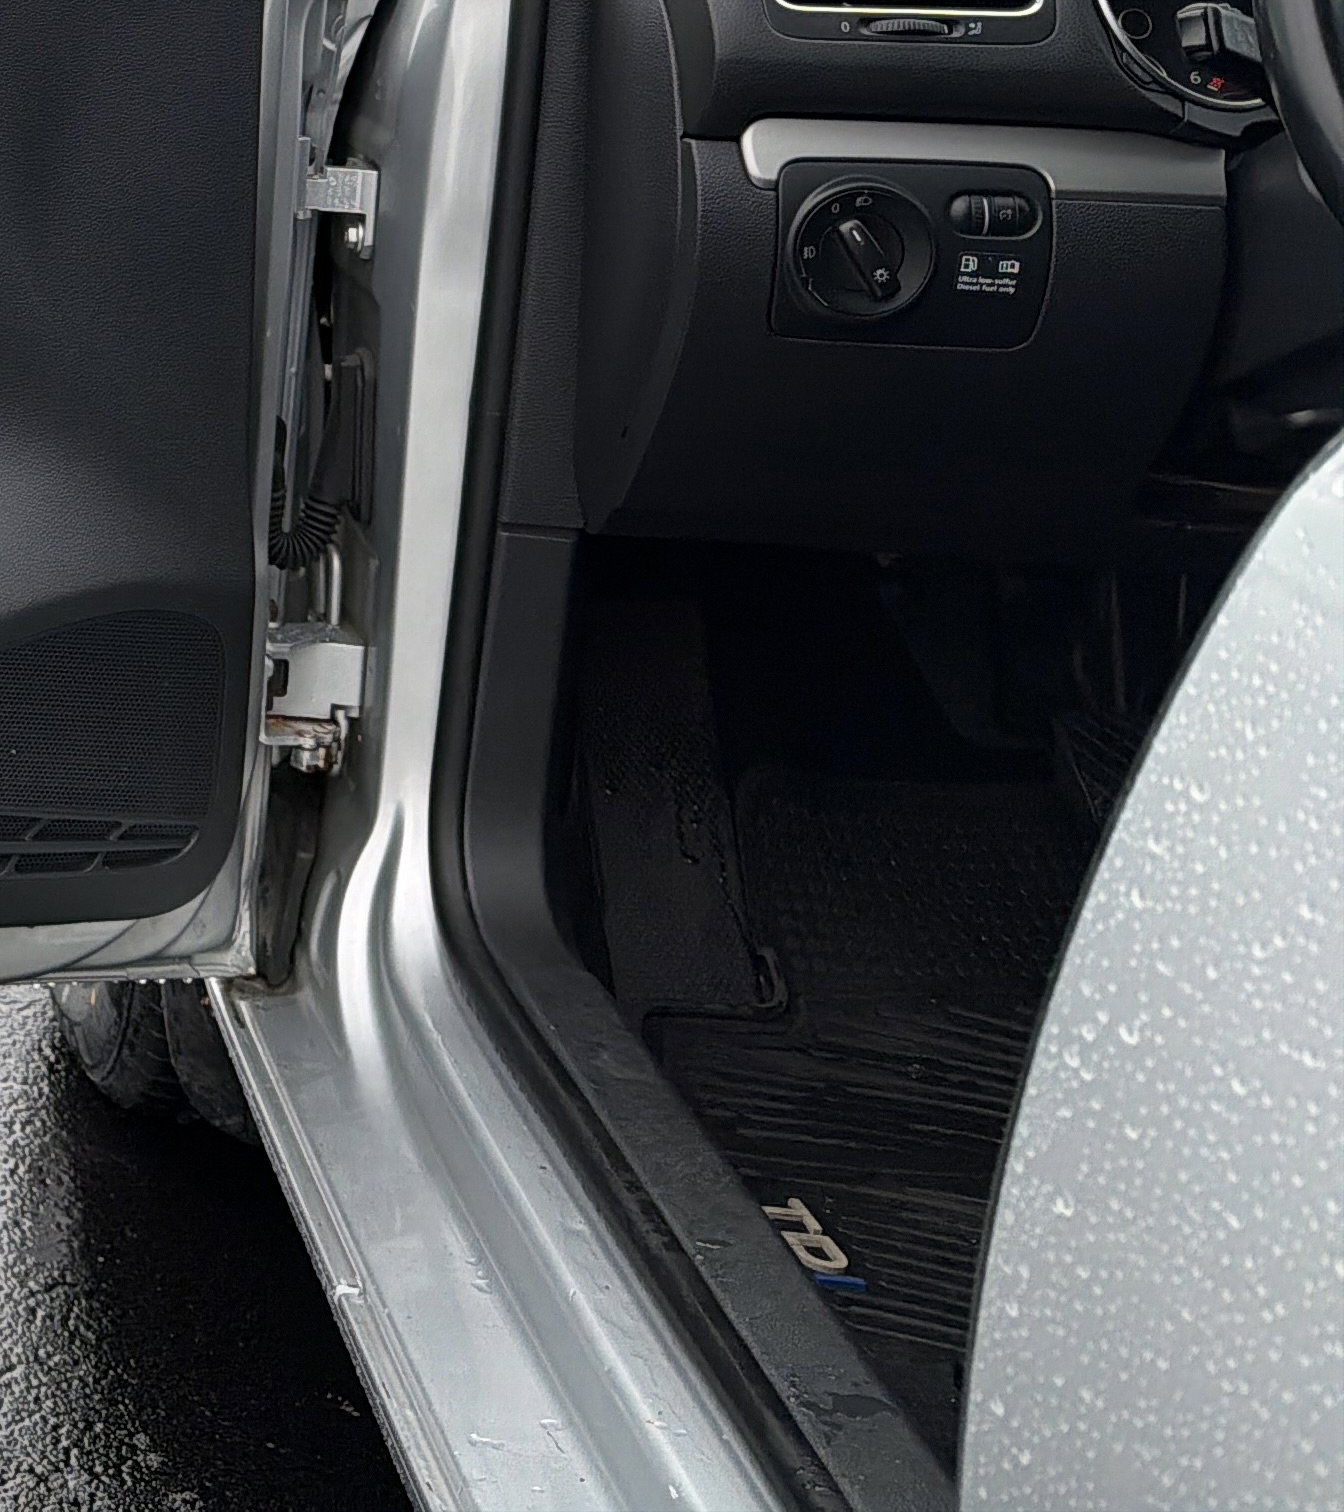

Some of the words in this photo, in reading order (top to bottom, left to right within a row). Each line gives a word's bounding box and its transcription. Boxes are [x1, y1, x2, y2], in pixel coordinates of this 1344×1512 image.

[1189, 71, 1202, 85] 6
[957, 283, 980, 291] Diesel
[998, 287, 1016, 295] only
[760, 1197, 866, 1292] TDI
